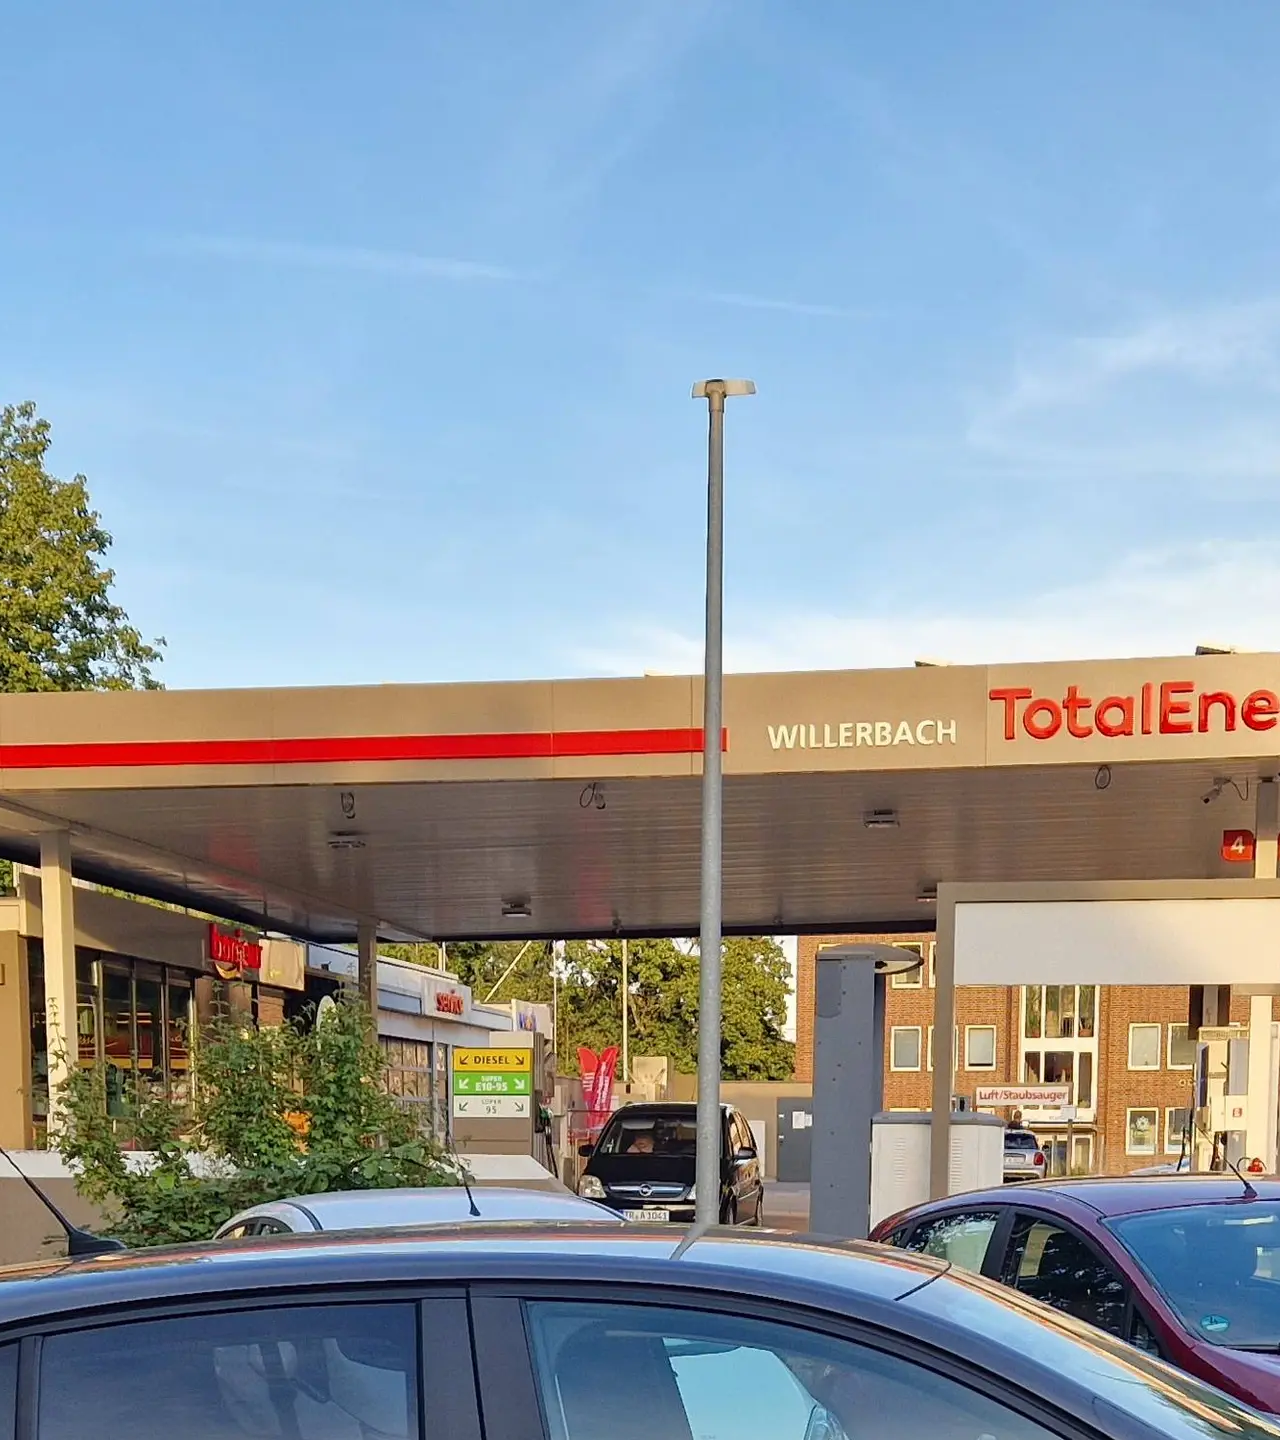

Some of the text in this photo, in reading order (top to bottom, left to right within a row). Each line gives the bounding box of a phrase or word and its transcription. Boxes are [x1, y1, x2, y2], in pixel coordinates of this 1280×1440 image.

[767, 719, 957, 750] WILLERBACH
[1230, 835, 1246, 855] 4
[473, 1055, 510, 1065] DIESEL
[475, 1082, 508, 1092] E10-95
[979, 1089, 1067, 1102] Luft/Staubsauger
[485, 1105, 497, 1115] 95
